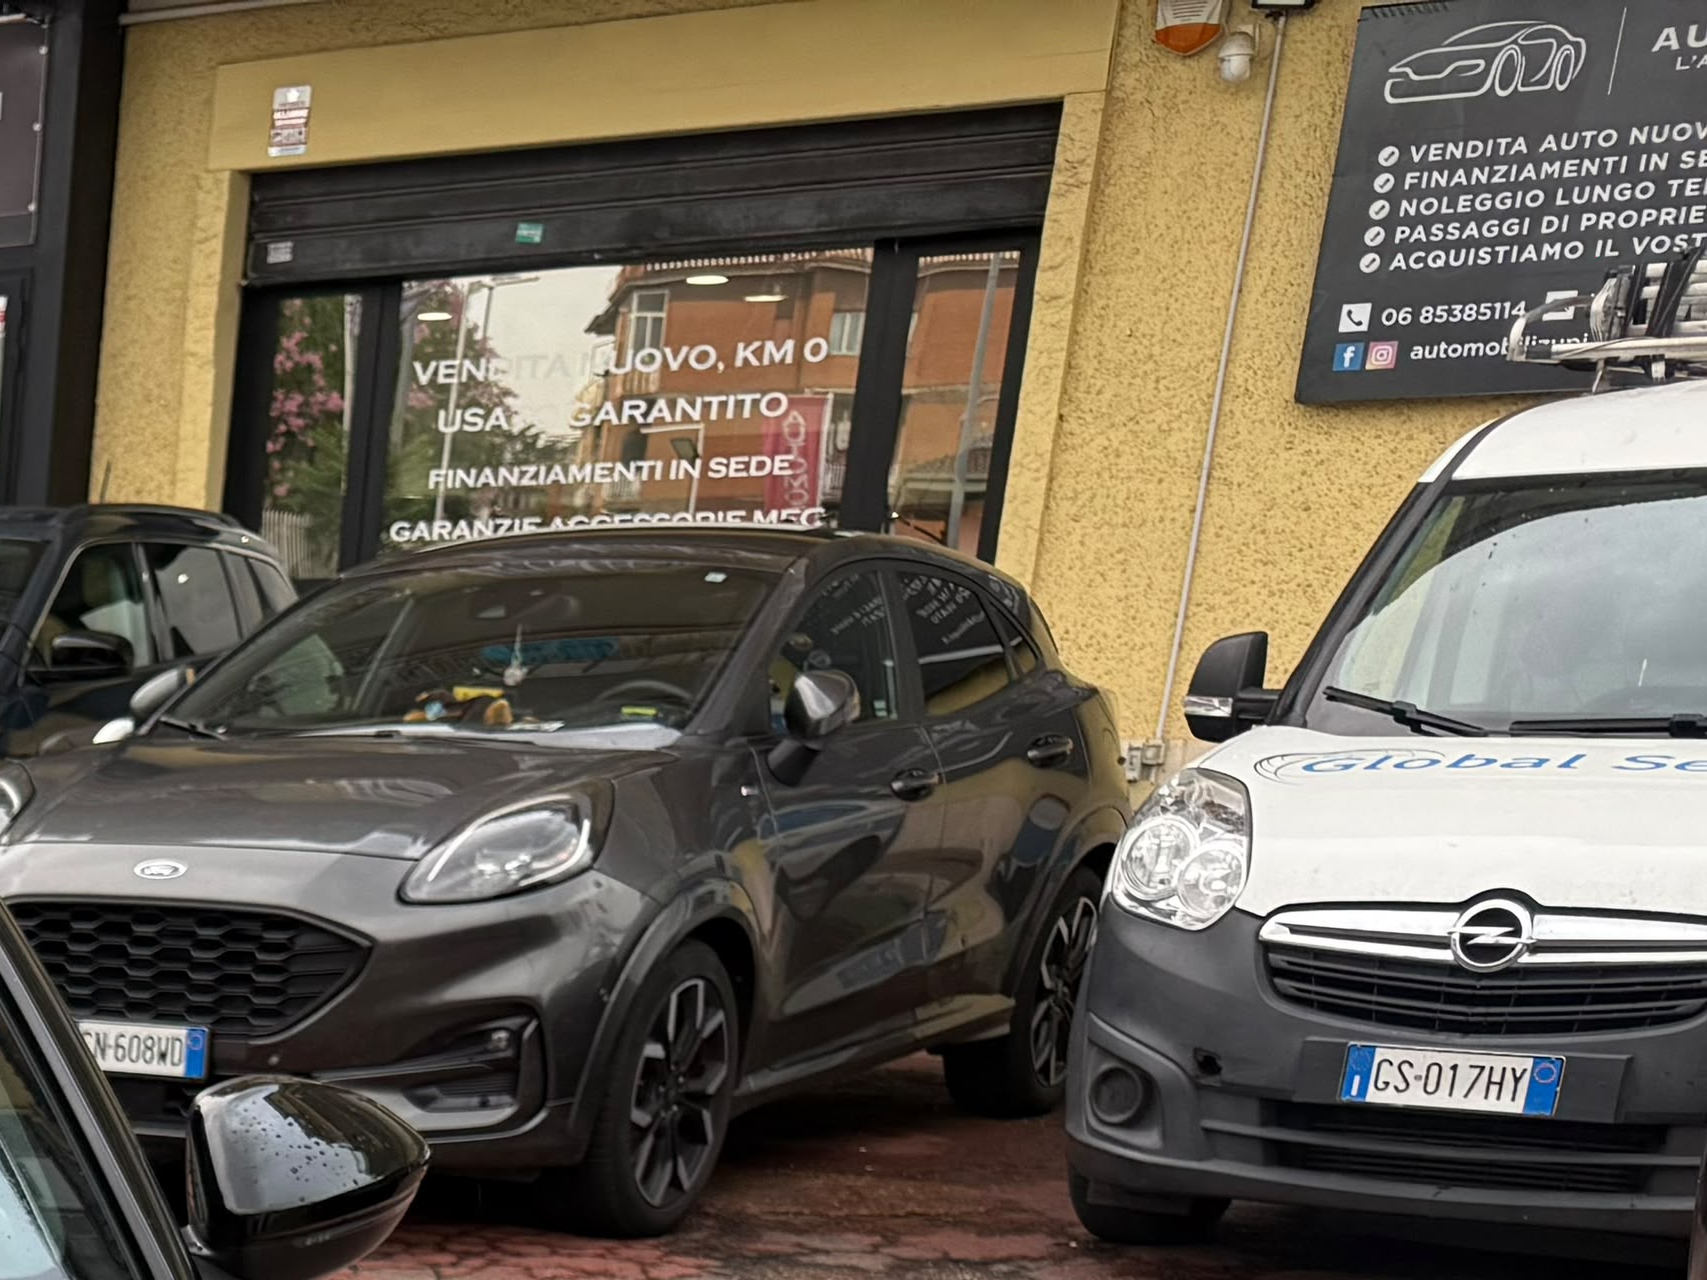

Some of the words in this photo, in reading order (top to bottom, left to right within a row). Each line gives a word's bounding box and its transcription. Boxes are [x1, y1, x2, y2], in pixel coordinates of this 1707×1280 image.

[1410, 136, 1528, 163] VENDITA
[1538, 128, 1618, 153] AUTO
[1403, 155, 1628, 190] FINANZIAMENTI
[1639, 151, 1670, 173] IN
[1398, 189, 1545, 217] NOLEGGIO
[1555, 181, 1656, 206] LUNGO
[1667, 177, 1707, 198] TE
[1394, 217, 1530, 244] PASSAGGI
[1541, 214, 1569, 235] DI
[1580, 205, 1707, 231] PROPRIE
[1389, 241, 1584, 271] ACQUISTIAMO
[1595, 239, 1619, 258] IL
[1381, 307, 1412, 328] 06
[1419, 300, 1526, 325] 85385114
[735, 339, 795, 367] KM
[569, 391, 788, 428] GARANTITO
[428, 460, 663, 490] FINANZIAMENTI
[670, 459, 701, 480] IN
[708, 455, 795, 479] SEDE
[389, 517, 543, 542] GARANZIE
[1301, 753, 1586, 773] Global
